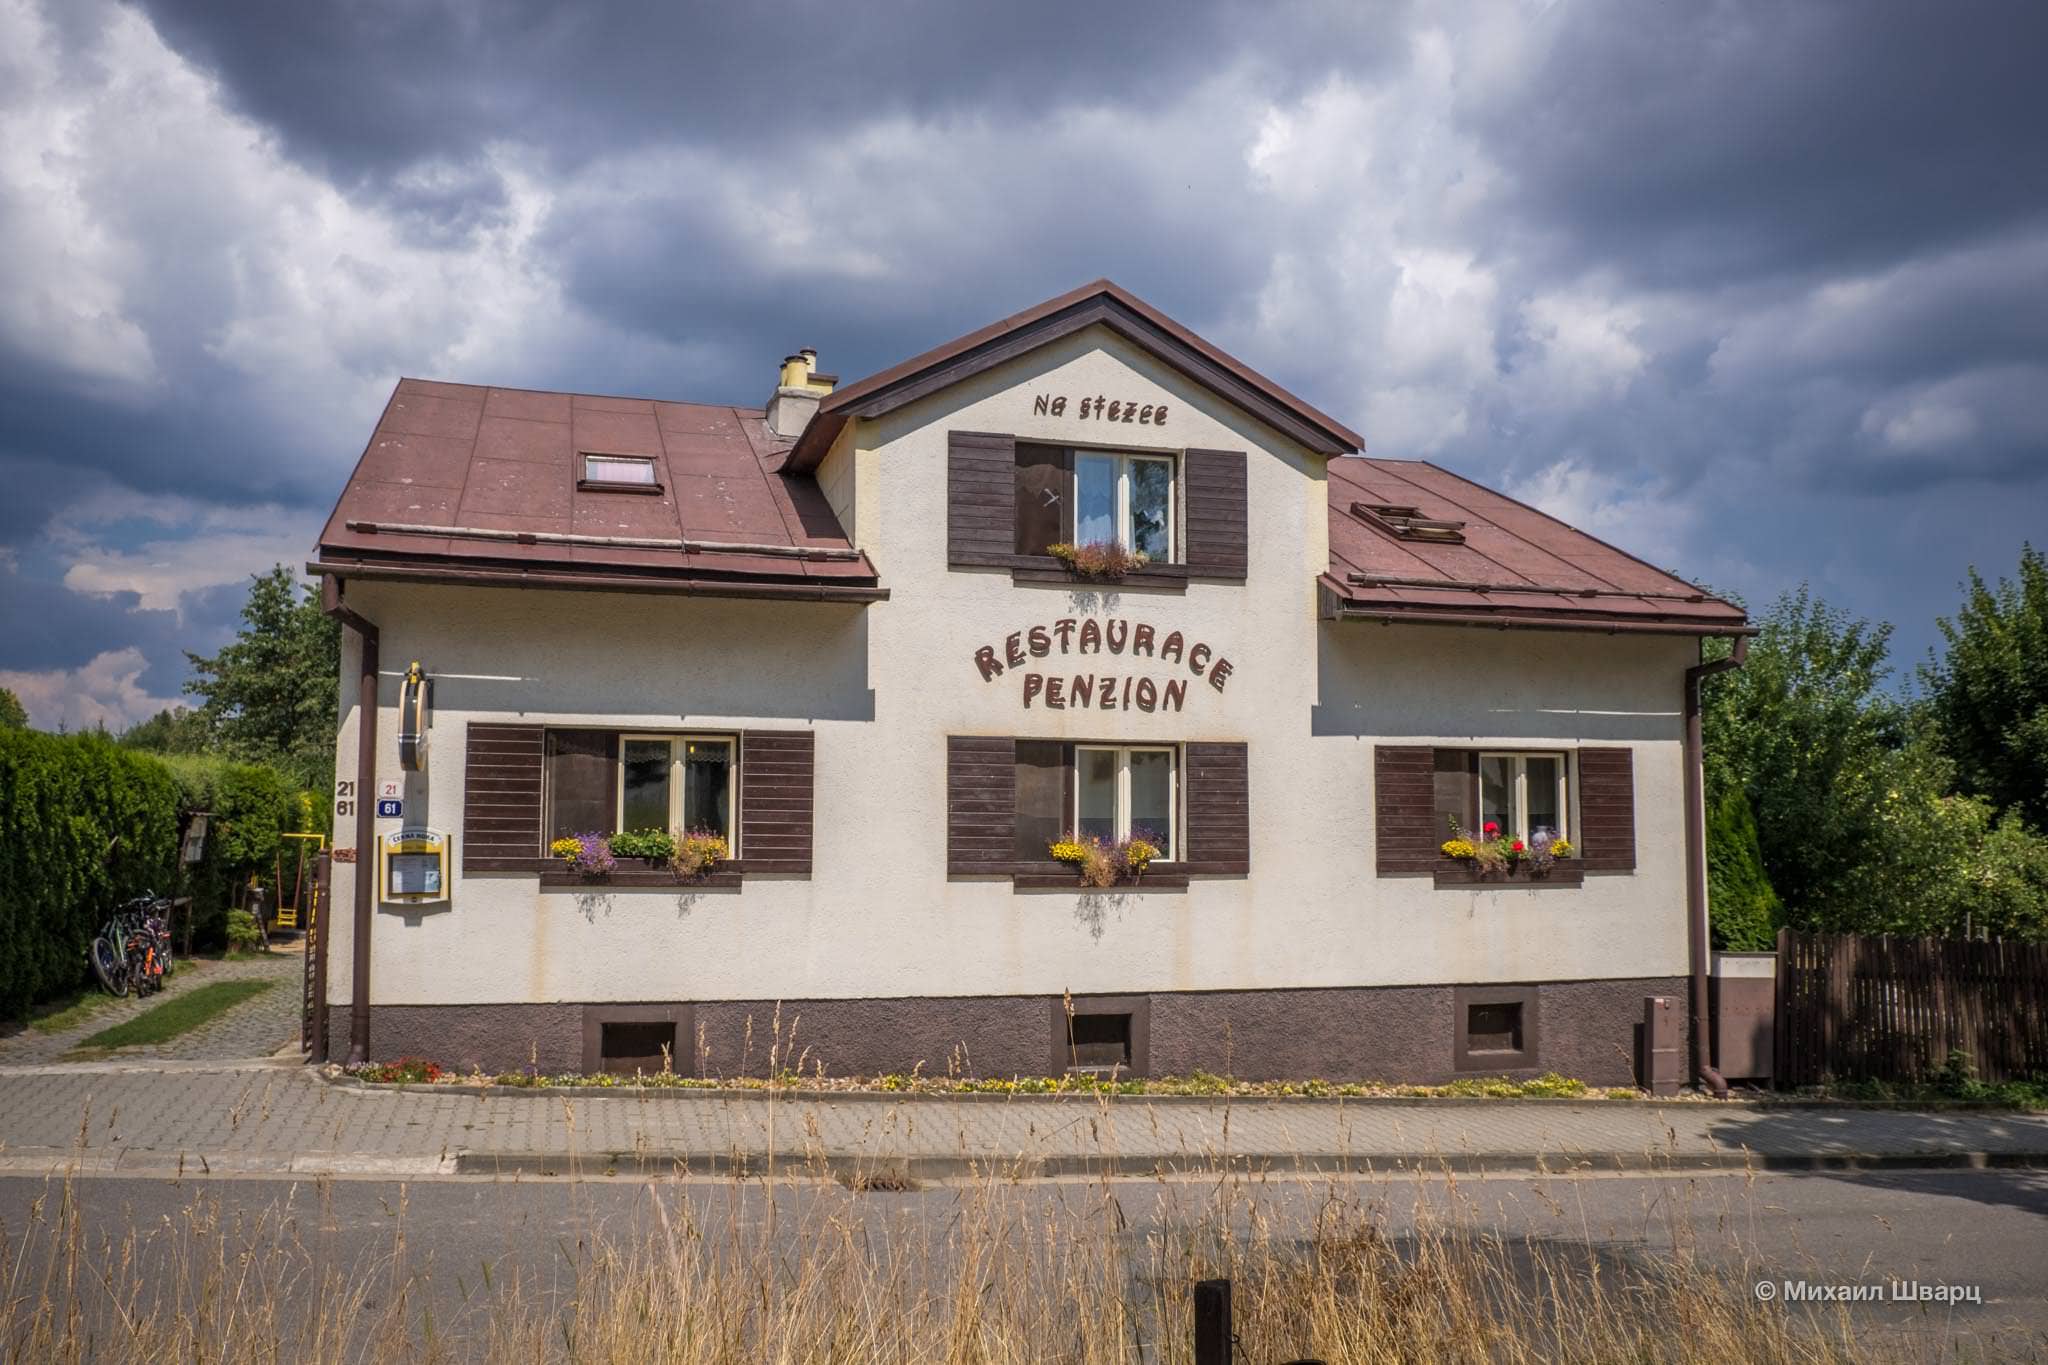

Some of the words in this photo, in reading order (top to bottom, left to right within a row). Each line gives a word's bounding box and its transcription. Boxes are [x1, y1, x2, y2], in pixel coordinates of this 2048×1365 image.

[1033, 393, 1068, 417] Na
[974, 618, 1234, 694] RESTAURACE
[1023, 673, 1188, 713] PENZION
[337, 781, 354, 797] 21
[385, 784, 396, 795] 21
[384, 803, 396, 814] 61
